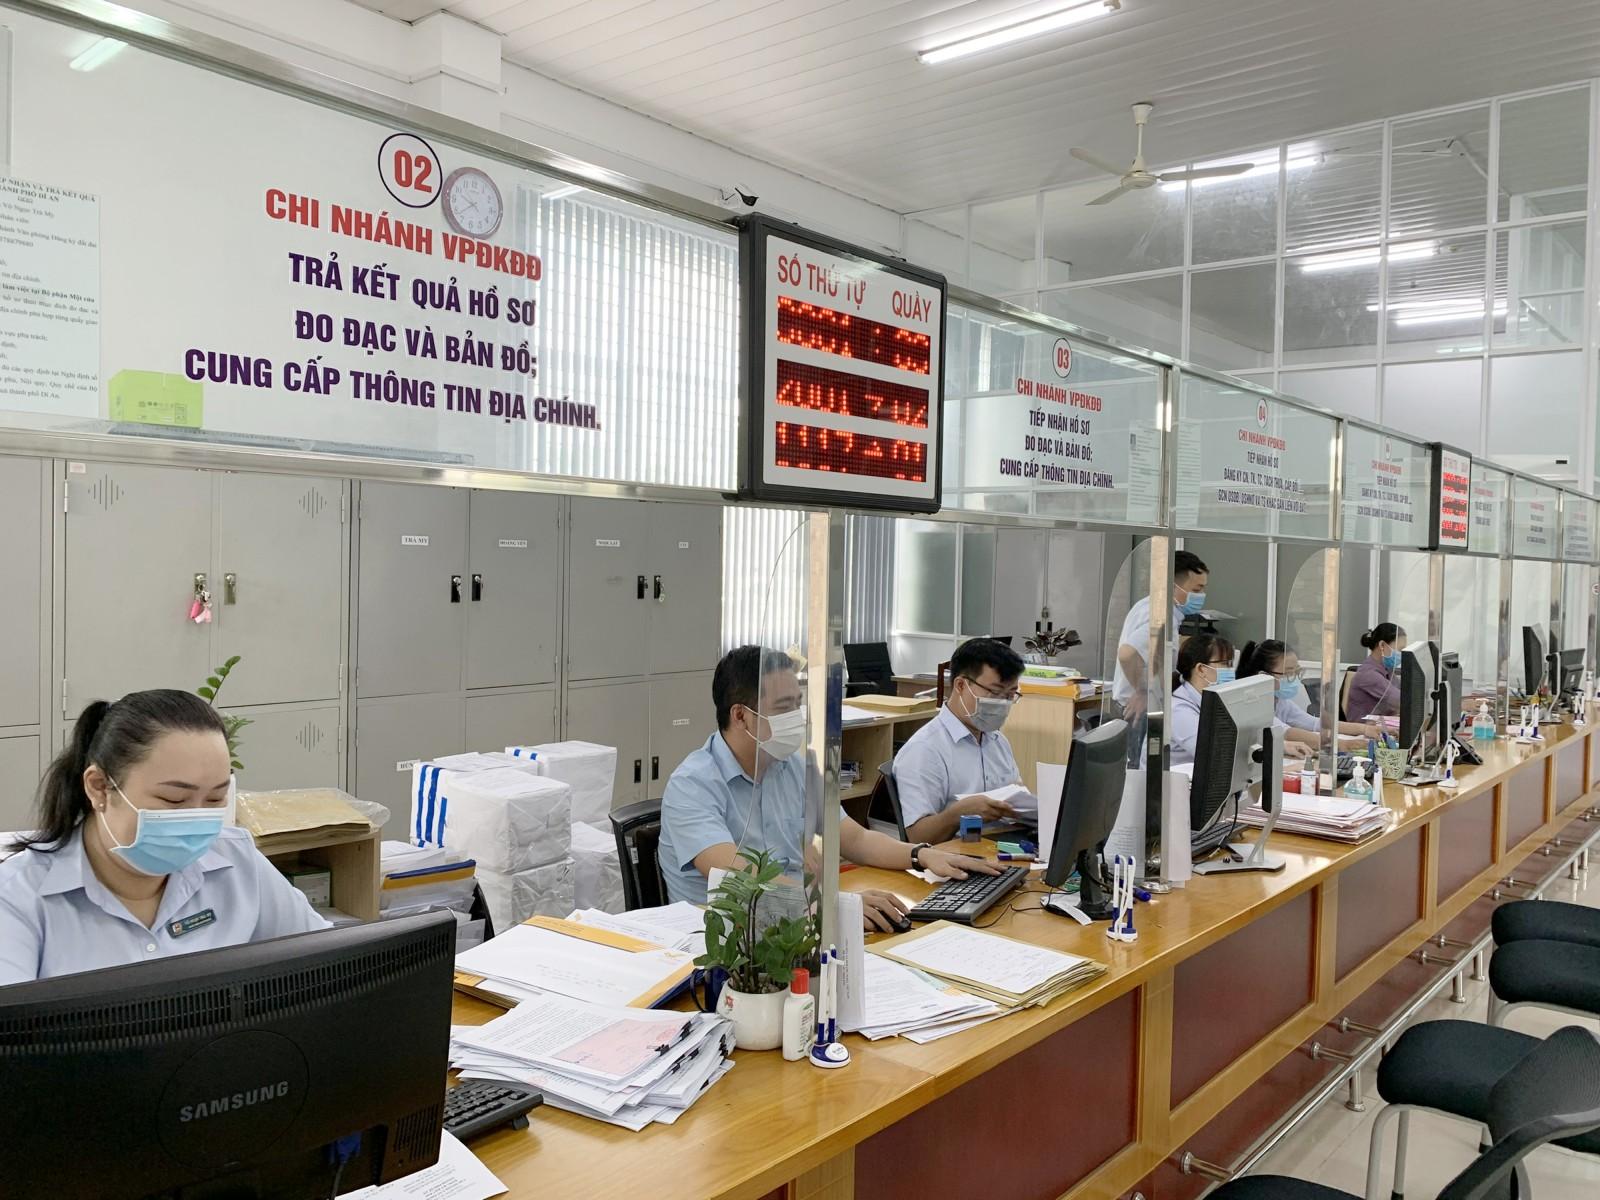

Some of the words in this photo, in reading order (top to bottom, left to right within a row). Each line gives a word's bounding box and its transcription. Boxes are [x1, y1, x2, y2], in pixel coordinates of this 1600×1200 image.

[394, 150, 432, 193] 02
[265, 189, 320, 229] CHI
[331, 211, 433, 255] NHÁNH
[442, 232, 542, 281] VPĐKĐĐ
[778, 253, 801, 286] SỐ
[288, 251, 343, 291] TRẢ
[352, 262, 400, 301] KẾT
[412, 276, 461, 313] QUẢ
[469, 285, 499, 320] HỒ
[507, 298, 537, 326] SƠ
[892, 290, 932, 323] QUẦY
[295, 310, 333, 343] ĐO
[343, 317, 396, 355] ĐẠC
[405, 325, 438, 360] VÀ
[445, 330, 494, 369] BẢN
[501, 340, 537, 379] ĐỒ;
[1057, 347, 1069, 370] 03
[185, 349, 272, 388] CUNG
[283, 355, 341, 396] CẤP
[350, 370, 435, 408] THÔNG
[444, 383, 481, 414] TIN
[489, 390, 527, 424] ĐỊA
[534, 396, 601, 430] CHÍNH.
[1017, 378, 1033, 396] CHI
[1036, 382, 1067, 404] NHÁNH
[1029, 407, 1046, 427] TIẾP
[1048, 412, 1068, 434] NHẬN
[1080, 419, 1091, 436] SƠ
[1025, 434, 1036, 451] ĐO
[1038, 436, 1053, 457] ĐẠC
[1000, 458, 1022, 477] CUNG
[1024, 458, 1039, 478] CẤP
[1041, 462, 1065, 482] THÔNG
[1067, 468, 1078, 484] TIN
[1079, 470, 1091, 489] ĐỊA
[180, 1080, 288, 1122] SAMSUNG
